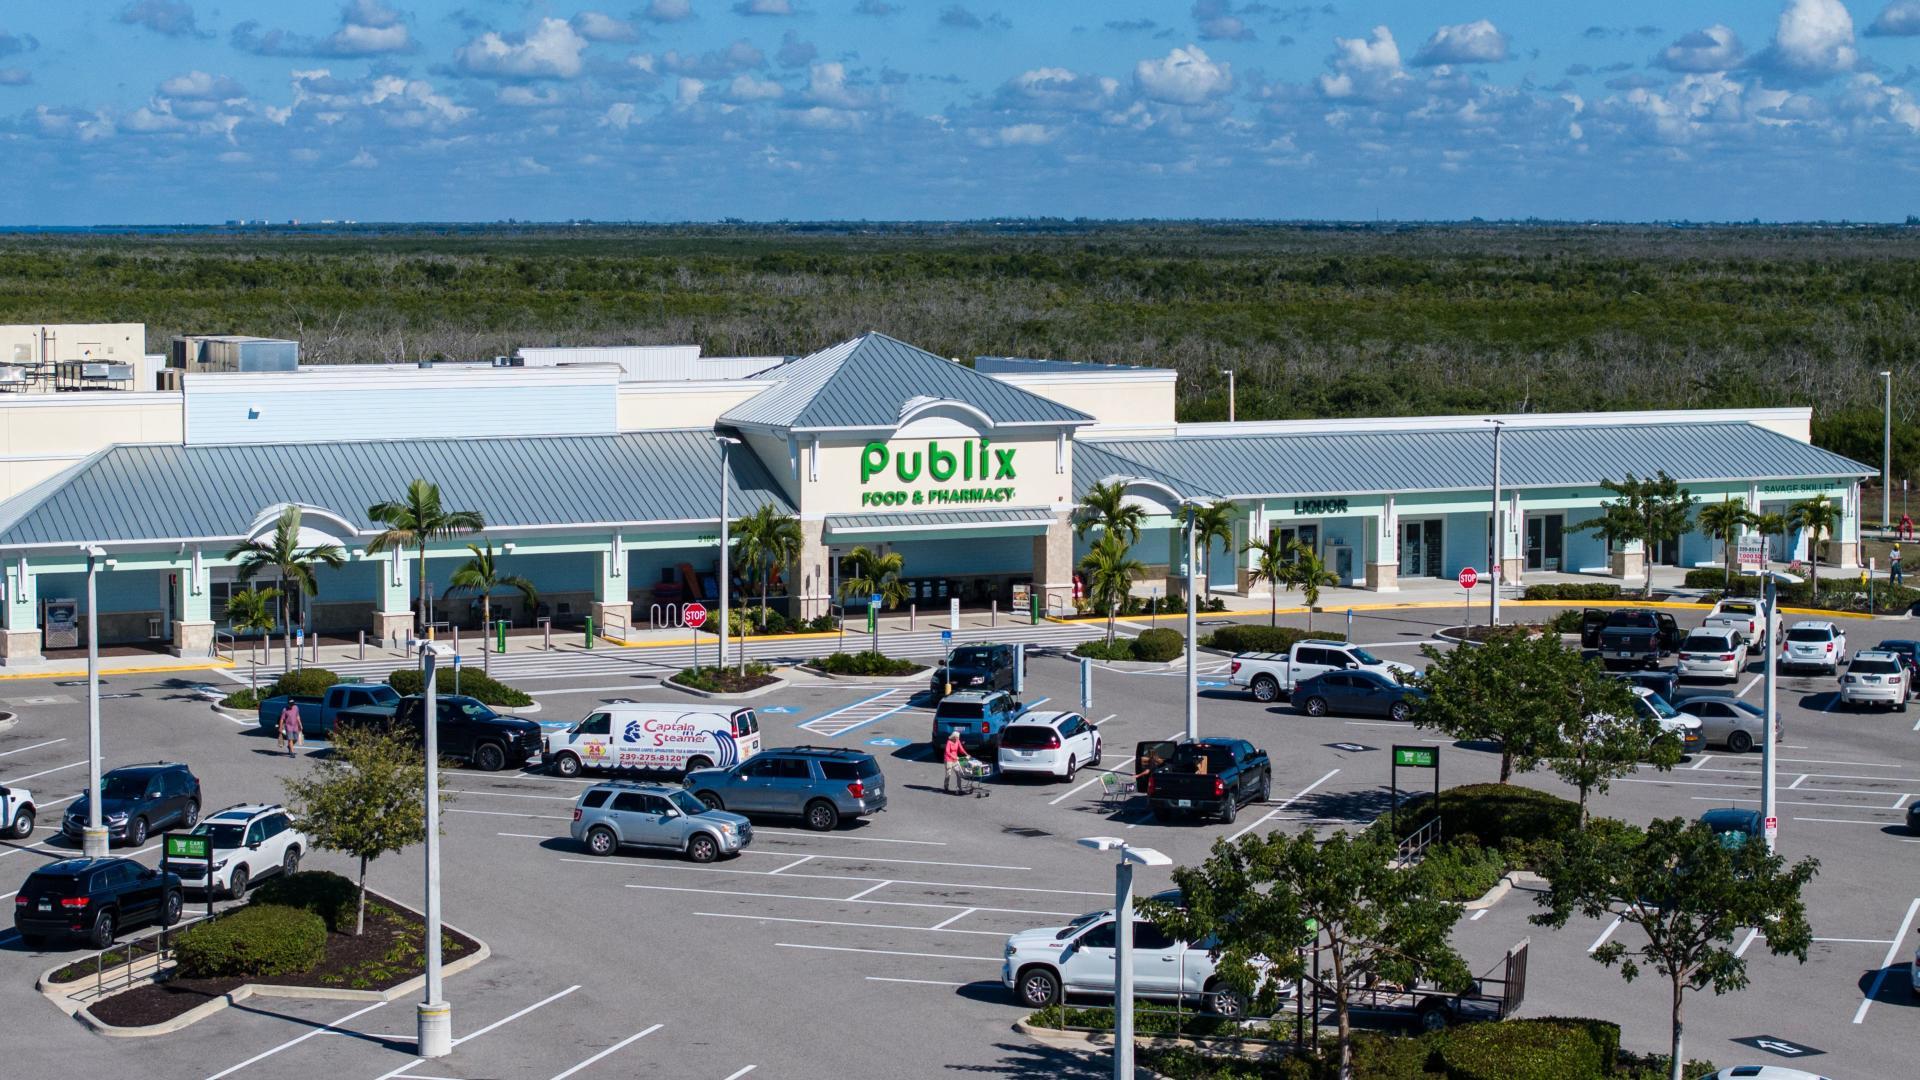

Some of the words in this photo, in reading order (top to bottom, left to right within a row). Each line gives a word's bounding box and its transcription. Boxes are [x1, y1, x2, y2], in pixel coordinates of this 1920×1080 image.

[861, 439, 1017, 484] Publix
[1764, 484, 1798, 494] SAVAGE
[1800, 483, 1835, 492] SKILLET
[862, 491, 908, 507] FOOD
[912, 490, 924, 505] &
[928, 487, 1015, 504] PHARMACY
[1294, 499, 1349, 515] LIQUOR
[1460, 574, 1477, 583] STOP
[685, 610, 705, 620] STOP
[644, 719, 696, 733] Captain
[653, 733, 708, 746] Steamer
[589, 745, 601, 753] 24
[619, 753, 682, 762] 239-275-8120
